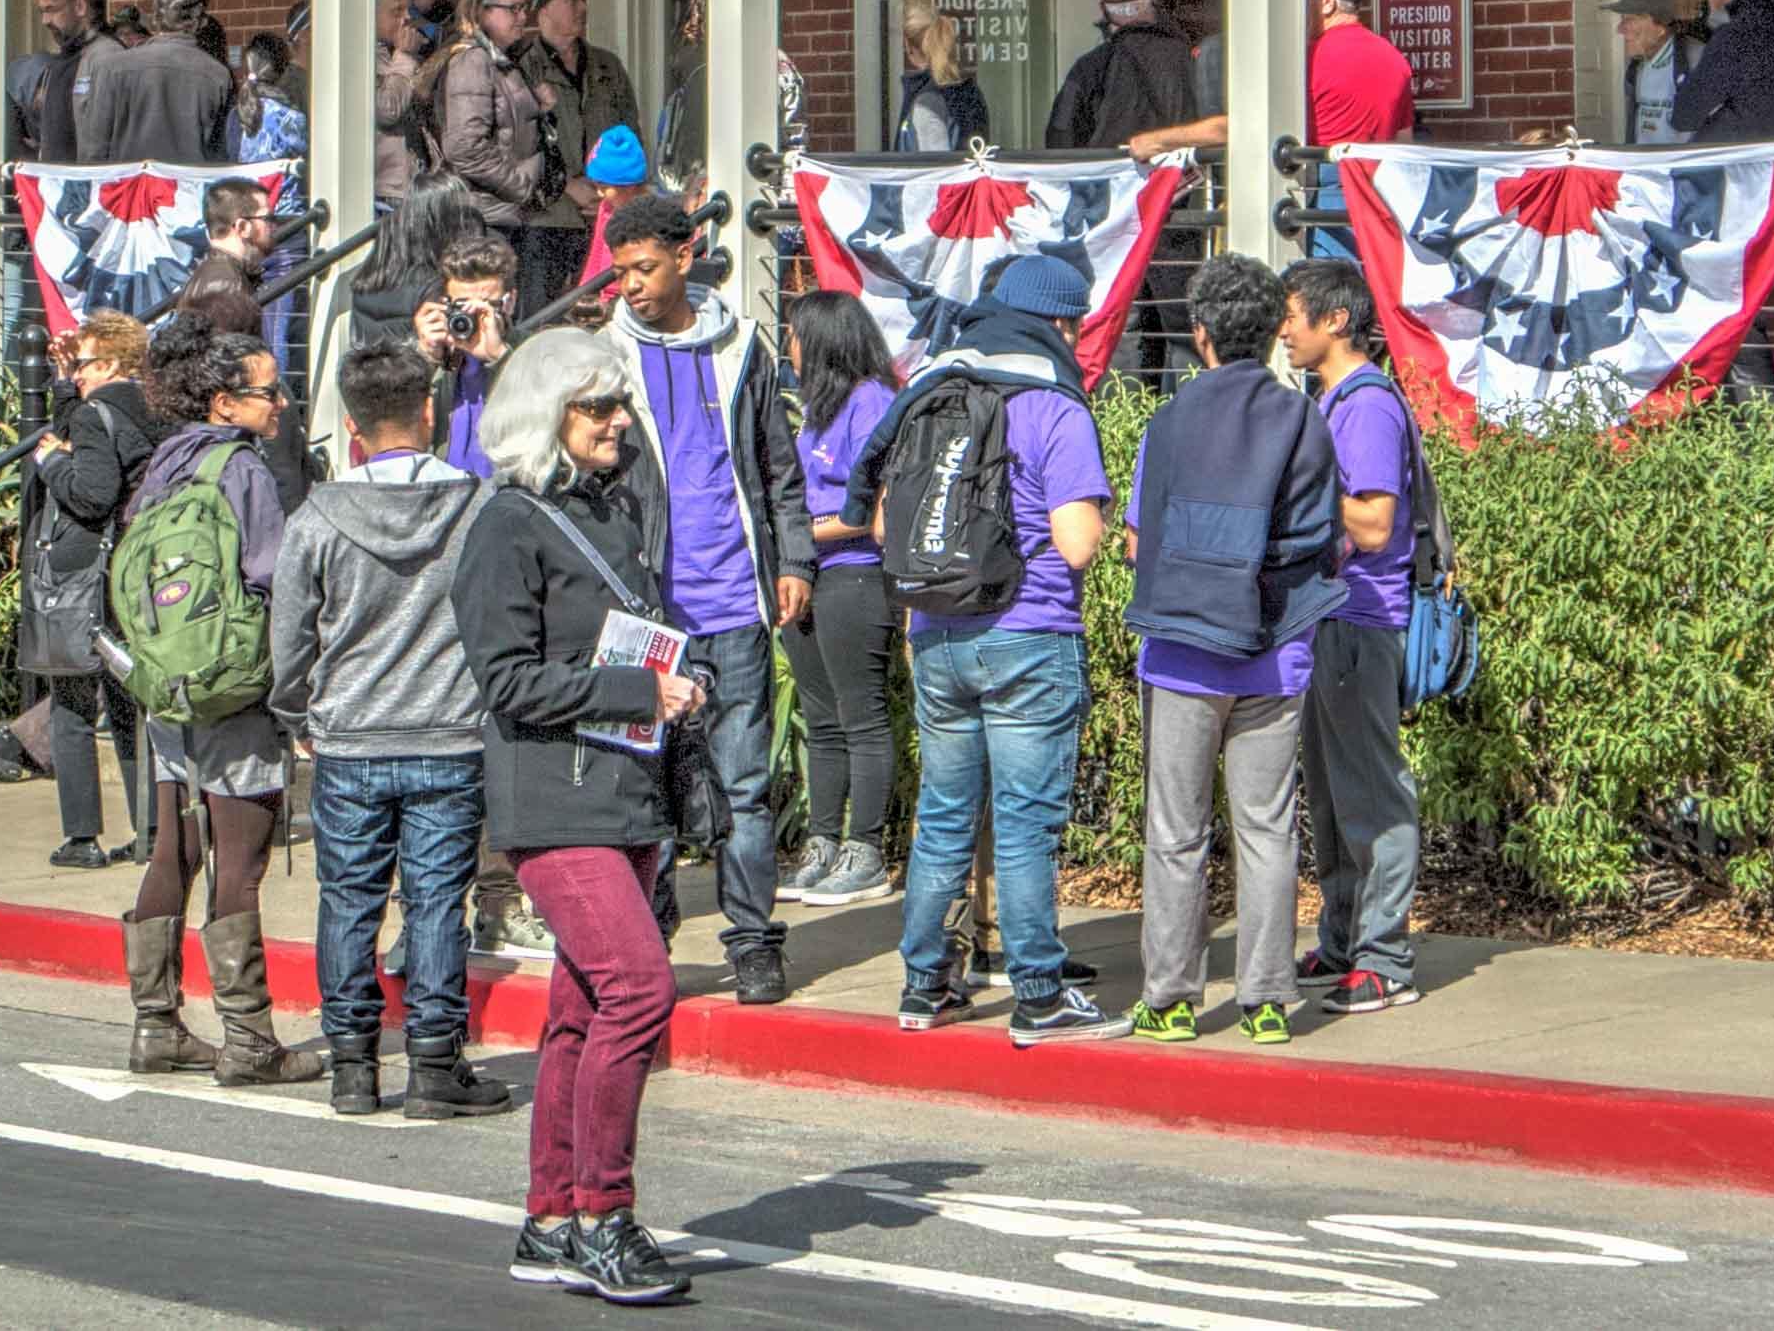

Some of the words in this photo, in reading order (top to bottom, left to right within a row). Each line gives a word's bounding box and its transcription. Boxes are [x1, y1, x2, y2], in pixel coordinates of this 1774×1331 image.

[1390, 5, 1452, 25] PRESIDIO
[1390, 28, 1452, 47] VISITOR
[1404, 51, 1452, 69] NTER
[924, 436, 970, 553] Supreme
